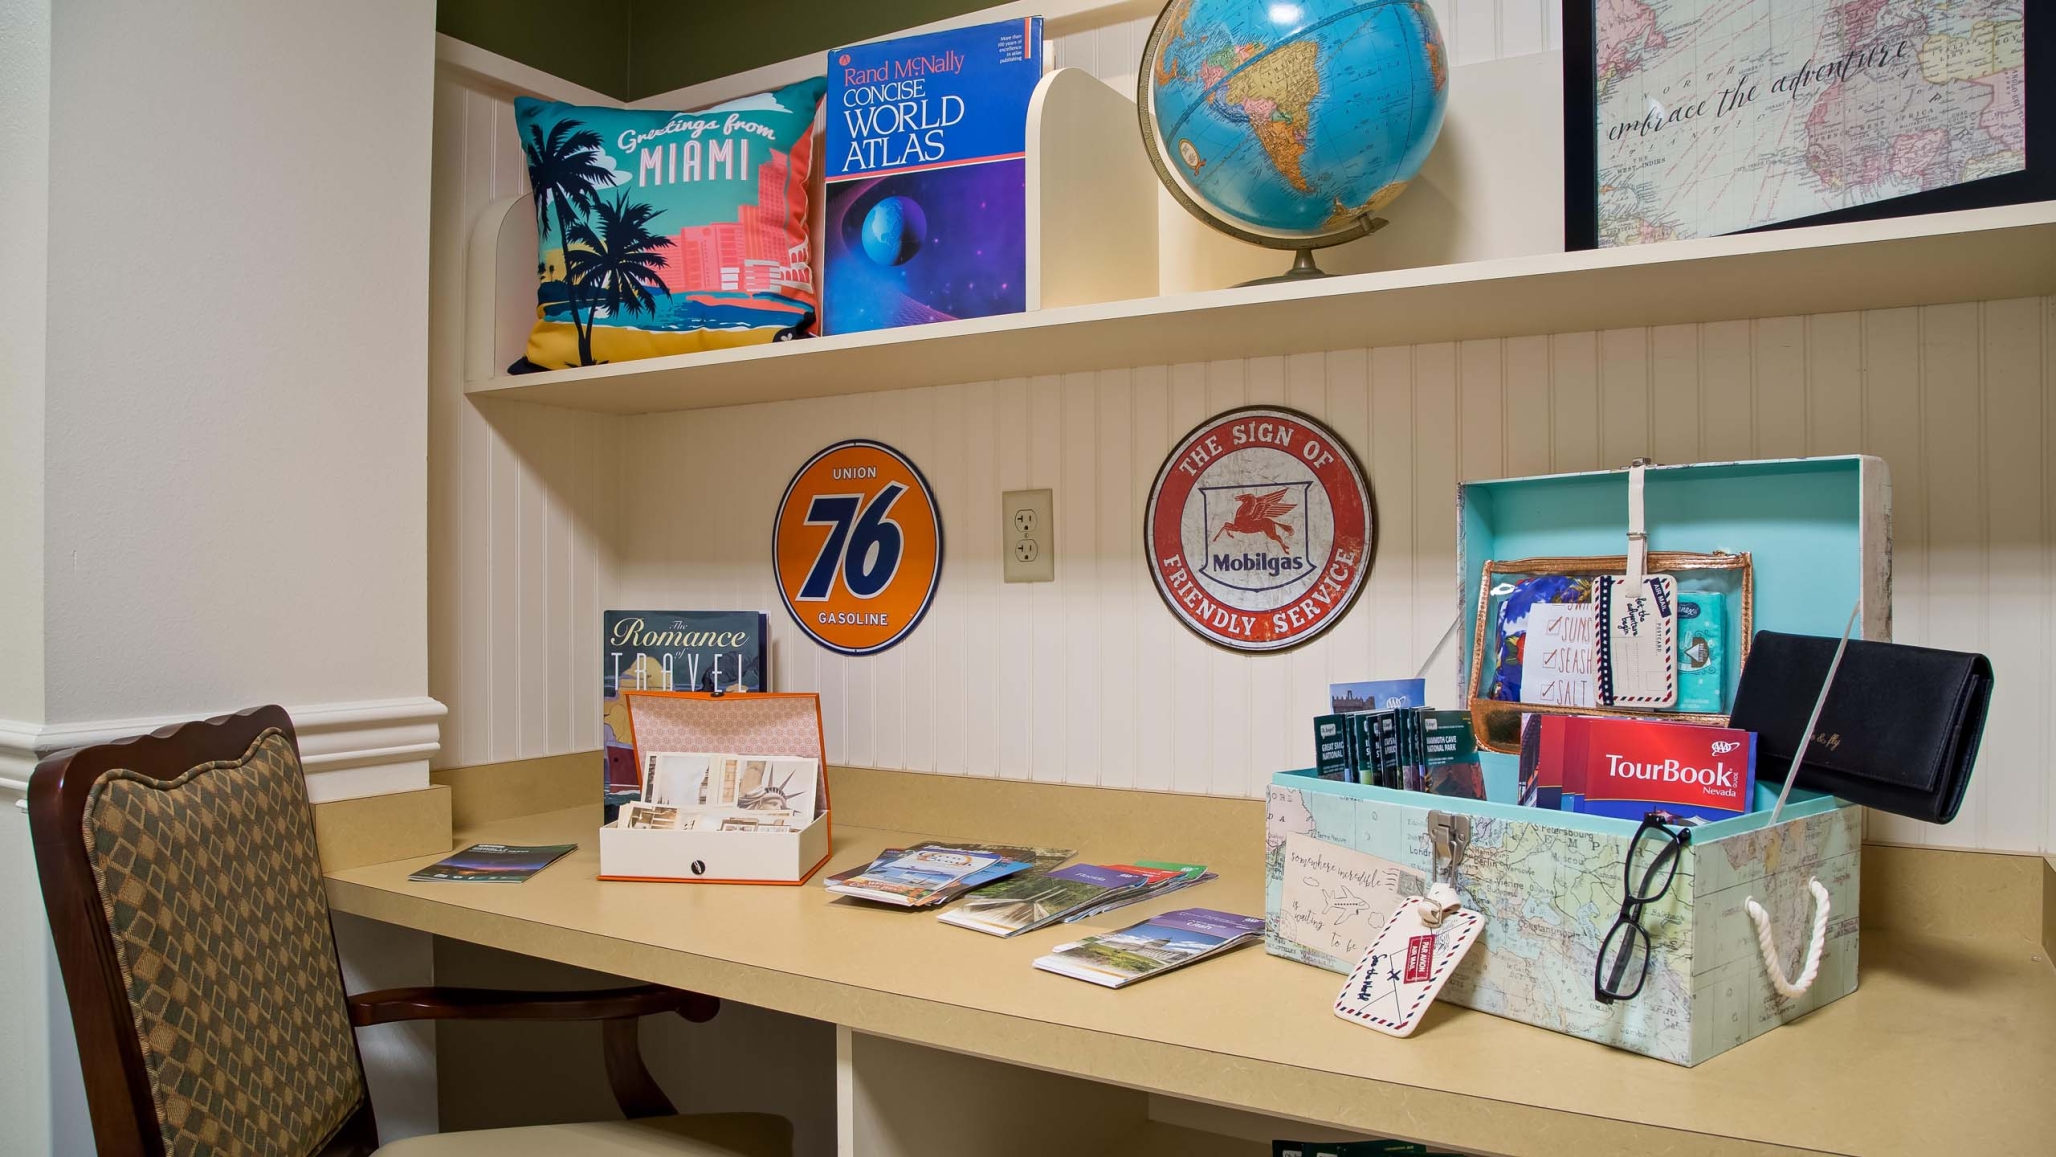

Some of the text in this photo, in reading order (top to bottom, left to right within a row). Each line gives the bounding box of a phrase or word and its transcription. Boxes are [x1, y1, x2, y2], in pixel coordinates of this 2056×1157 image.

[844, 51, 965, 87] Rand McNally
[843, 78, 926, 107] CONCISE
[1609, 41, 1912, 141] embrace the adventure
[843, 95, 965, 139] WORLD
[617, 113, 776, 154] Greetings from
[639, 138, 748, 188] MIAMI
[841, 129, 945, 172] ATLAS
[1178, 420, 1335, 478] THE SIGN OF
[832, 466, 877, 480] UNION
[794, 479, 910, 602] 76
[1213, 552, 1303, 577] Mobilgas
[1162, 547, 1356, 636] FRIENDLY SERVICE
[1653, 583, 1667, 612] AIR MAIL
[610, 617, 750, 648] Romance
[669, 620, 688, 631] The
[818, 611, 889, 626] GASOLINE
[675, 648, 689, 660] of
[611, 652, 749, 693] TRAVEL
[1556, 679, 1588, 706] SALT
[1321, 742, 1334, 752] GREAT
[1426, 735, 1457, 745] MAMMOTH CAVE
[1426, 743, 1457, 753] NATIONAL PARK
[1322, 750, 1343, 761] NATIONAL
[1605, 753, 1733, 788] TourBook
[1702, 786, 1737, 798] Nevada
[1290, 851, 1382, 888] somewhere incredible
[1473, 856, 1498, 869] Berlin
[1293, 909, 1325, 932] waiting
[1331, 930, 1357, 953] to be
[1418, 941, 1430, 973] PAR AVION
